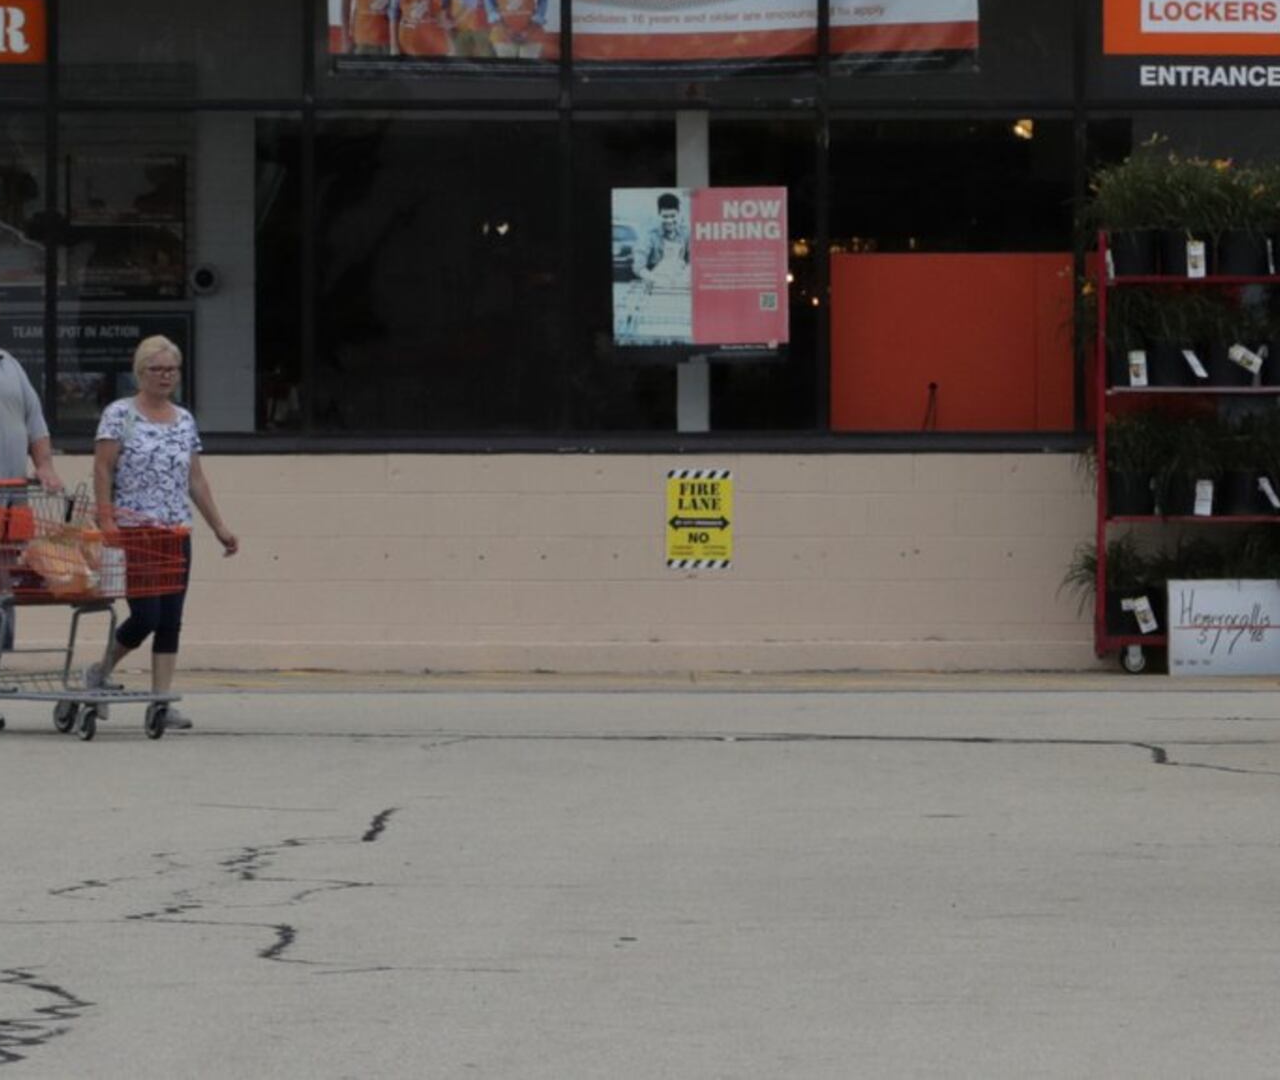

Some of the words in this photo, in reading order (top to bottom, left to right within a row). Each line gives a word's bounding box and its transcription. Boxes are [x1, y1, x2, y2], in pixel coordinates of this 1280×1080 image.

[1149, 1, 1278, 23] LOCKERS
[723, 200, 780, 219] NOW
[696, 221, 780, 240] HIRING
[680, 482, 720, 496] FIRE
[678, 498, 722, 511] LANE
[688, 532, 710, 544] NO
